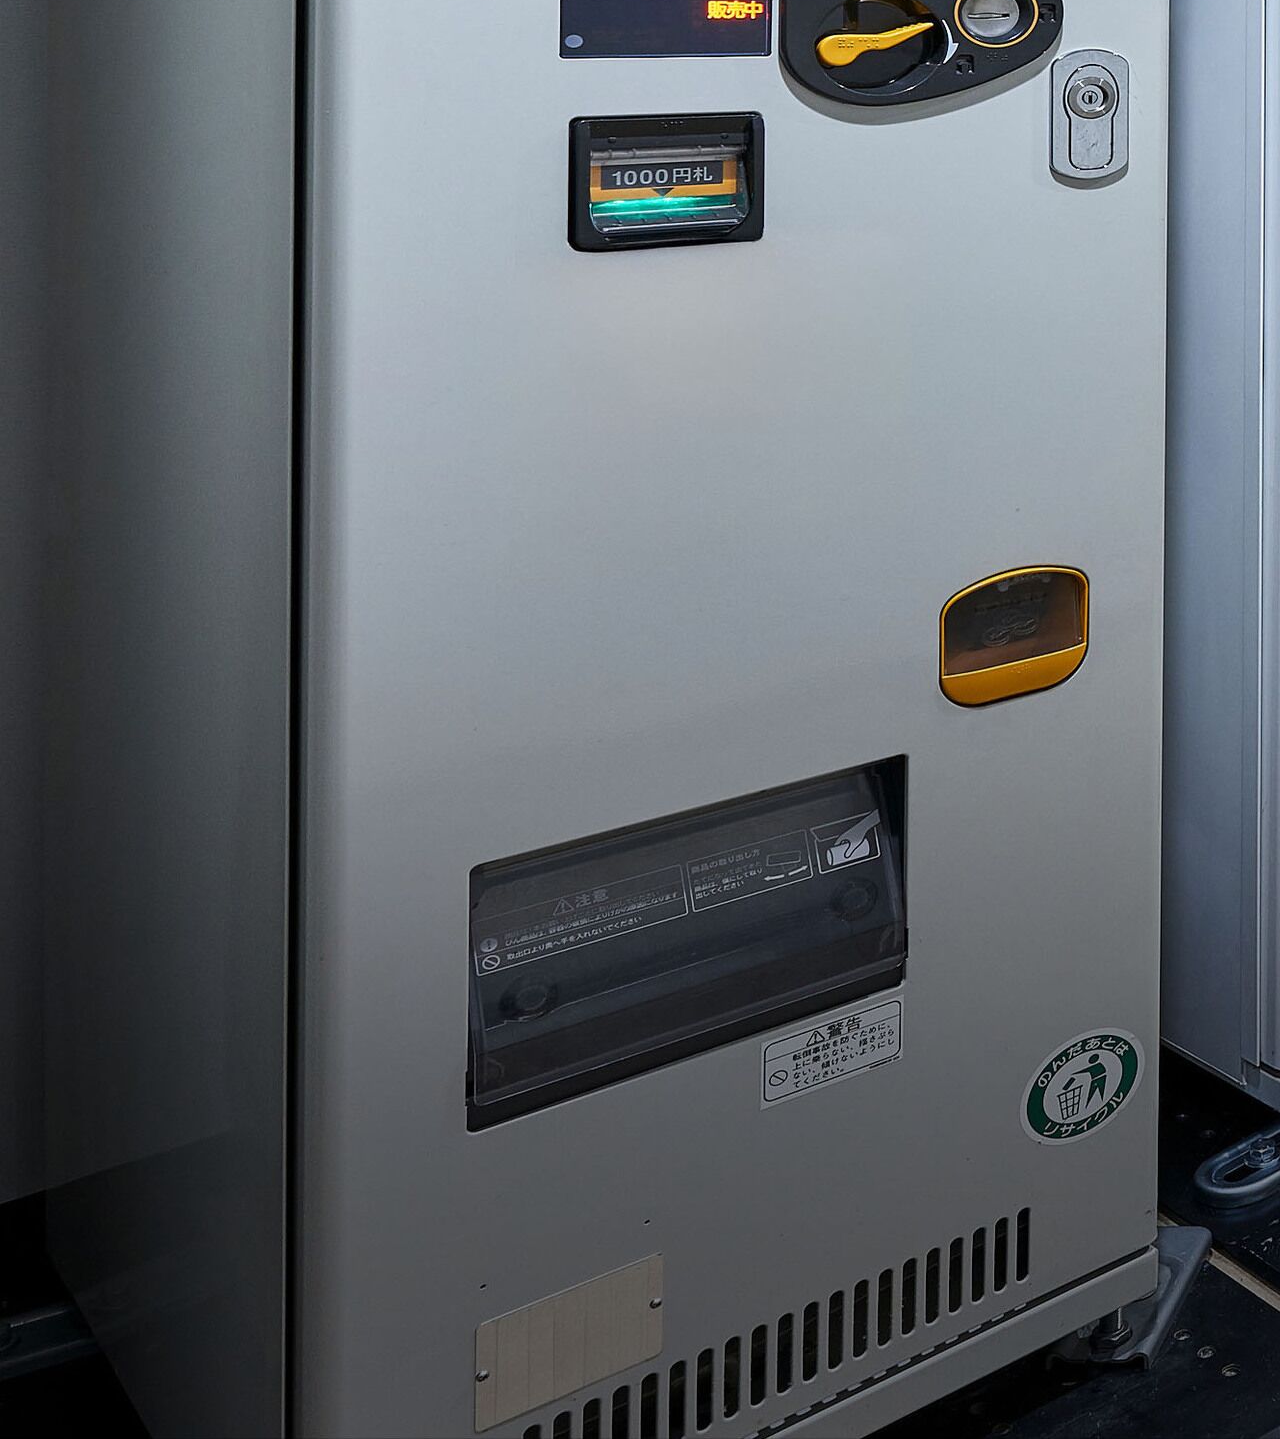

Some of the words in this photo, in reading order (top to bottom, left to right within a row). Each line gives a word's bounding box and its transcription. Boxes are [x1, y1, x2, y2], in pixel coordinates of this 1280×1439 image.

[706, 0, 764, 19] 販売中
[611, 166, 713, 186] 1000円札
[1037, 1036, 1129, 1087] のんだあとは
[1043, 1091, 1124, 1137] リサイクル
